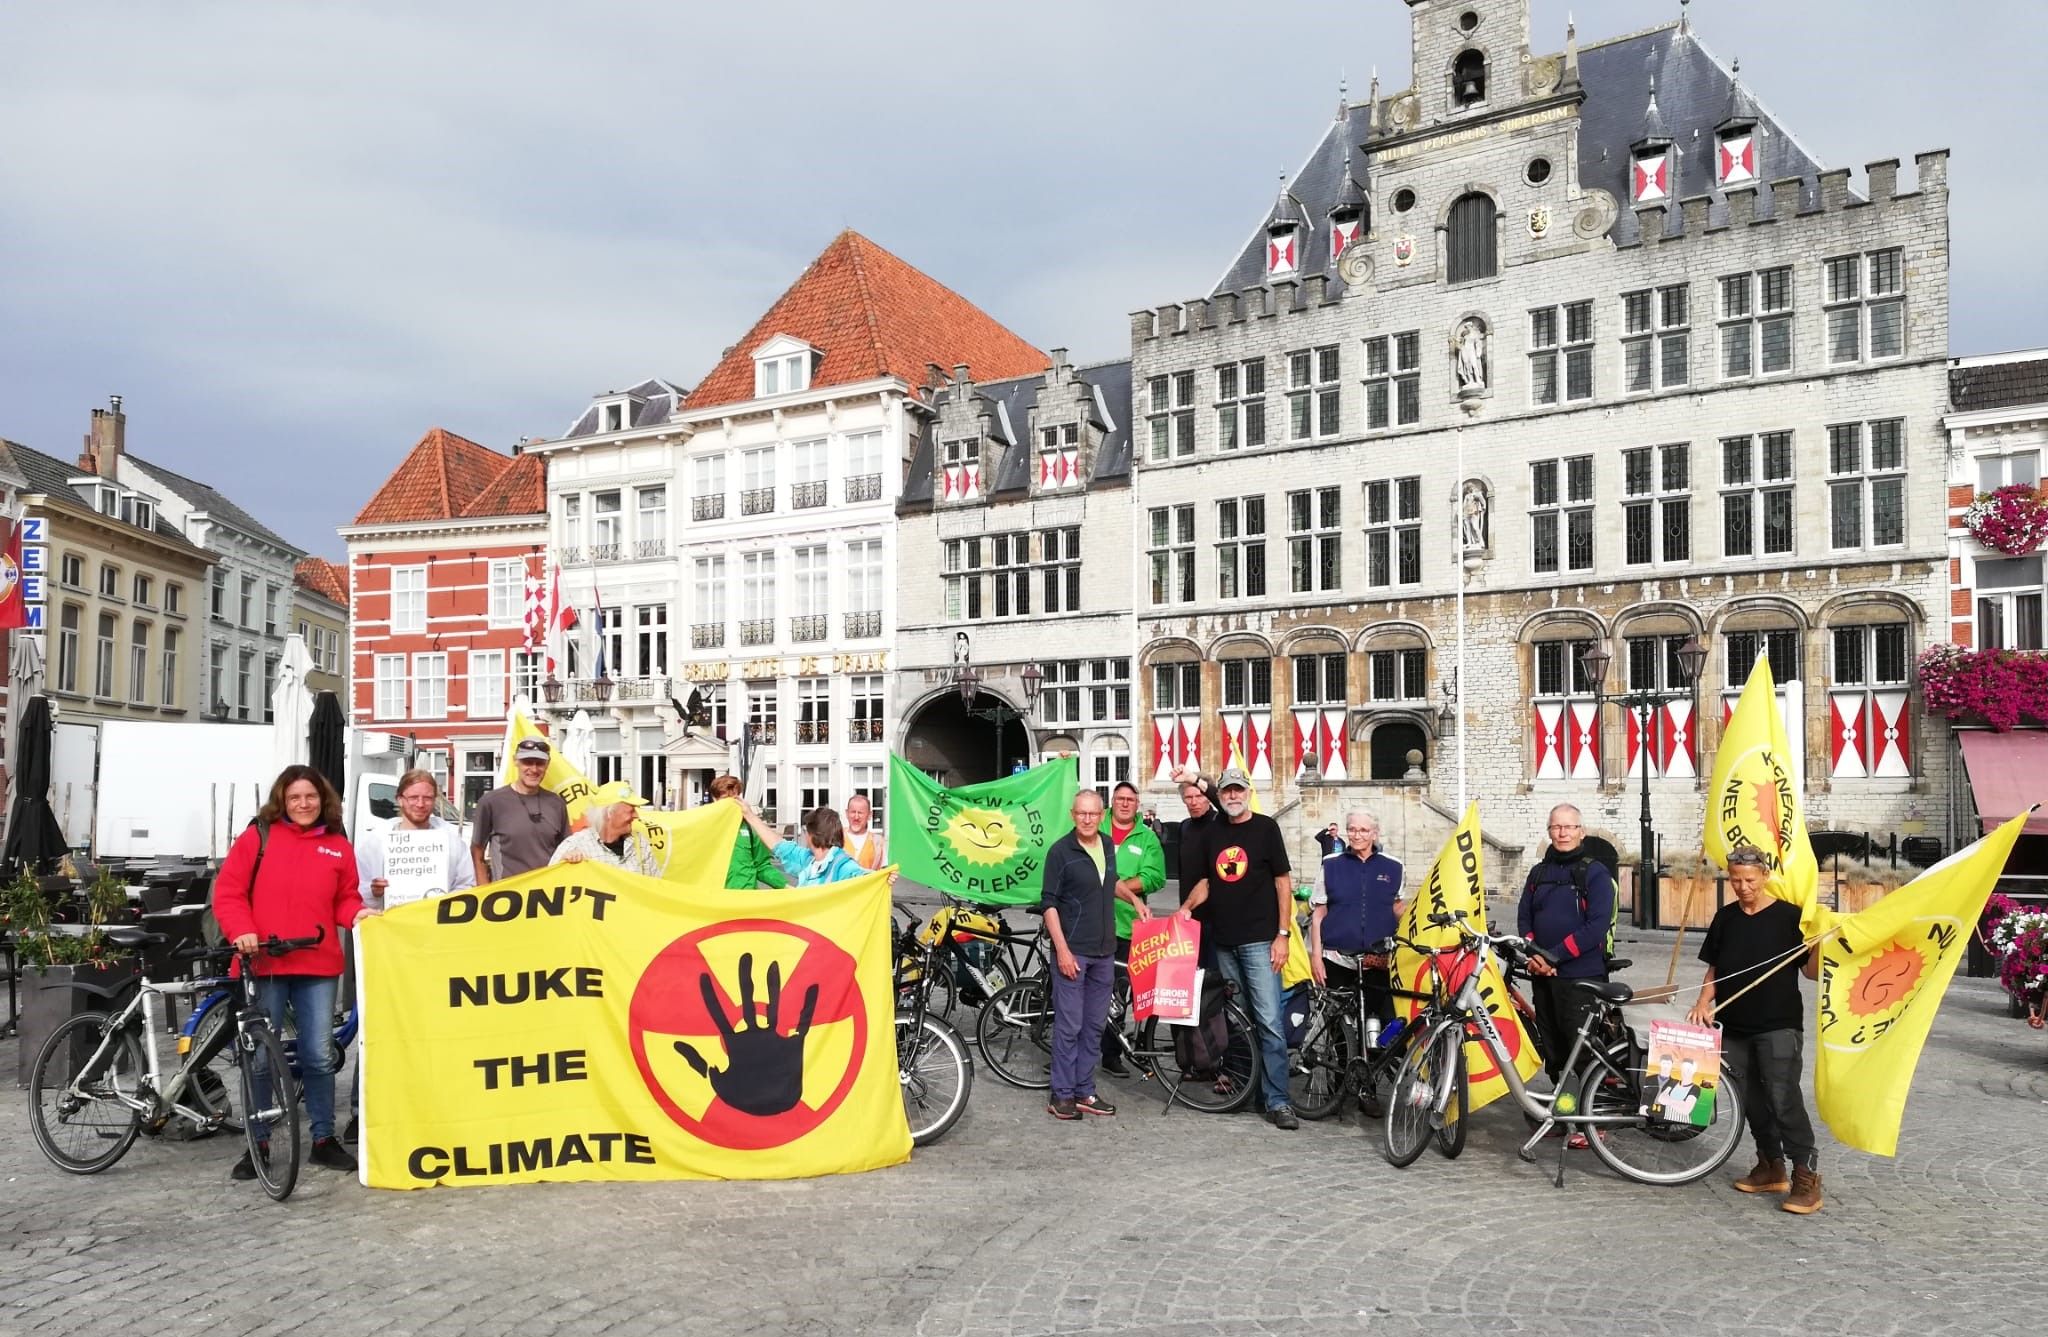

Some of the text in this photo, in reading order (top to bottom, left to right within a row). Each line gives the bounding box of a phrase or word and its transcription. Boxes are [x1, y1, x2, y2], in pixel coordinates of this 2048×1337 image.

[1376, 147, 1414, 162] MILLE
[1500, 106, 1568, 131] SUPERSUM
[684, 652, 887, 681] GRAND HOTEL DE DRAAK
[1723, 779, 1743, 822] NEE
[388, 833, 410, 845] Tijd
[388, 843, 443, 854] voor echt
[388, 856, 430, 867] groene
[388, 865, 437, 877] energie!
[933, 850, 1038, 893] YES PLEASE
[437, 886, 616, 925] DON'T
[1129, 941, 1195, 976] ENERGIE
[1131, 931, 1170, 957] KERN
[449, 967, 604, 1008] NUKE
[1154, 997, 1188, 1007] AFFICHE
[1160, 989, 1188, 998] GROEN
[1476, 1005, 1498, 1041] GIANT
[474, 1050, 587, 1090] THE
[408, 1133, 656, 1180] CLIMATE
